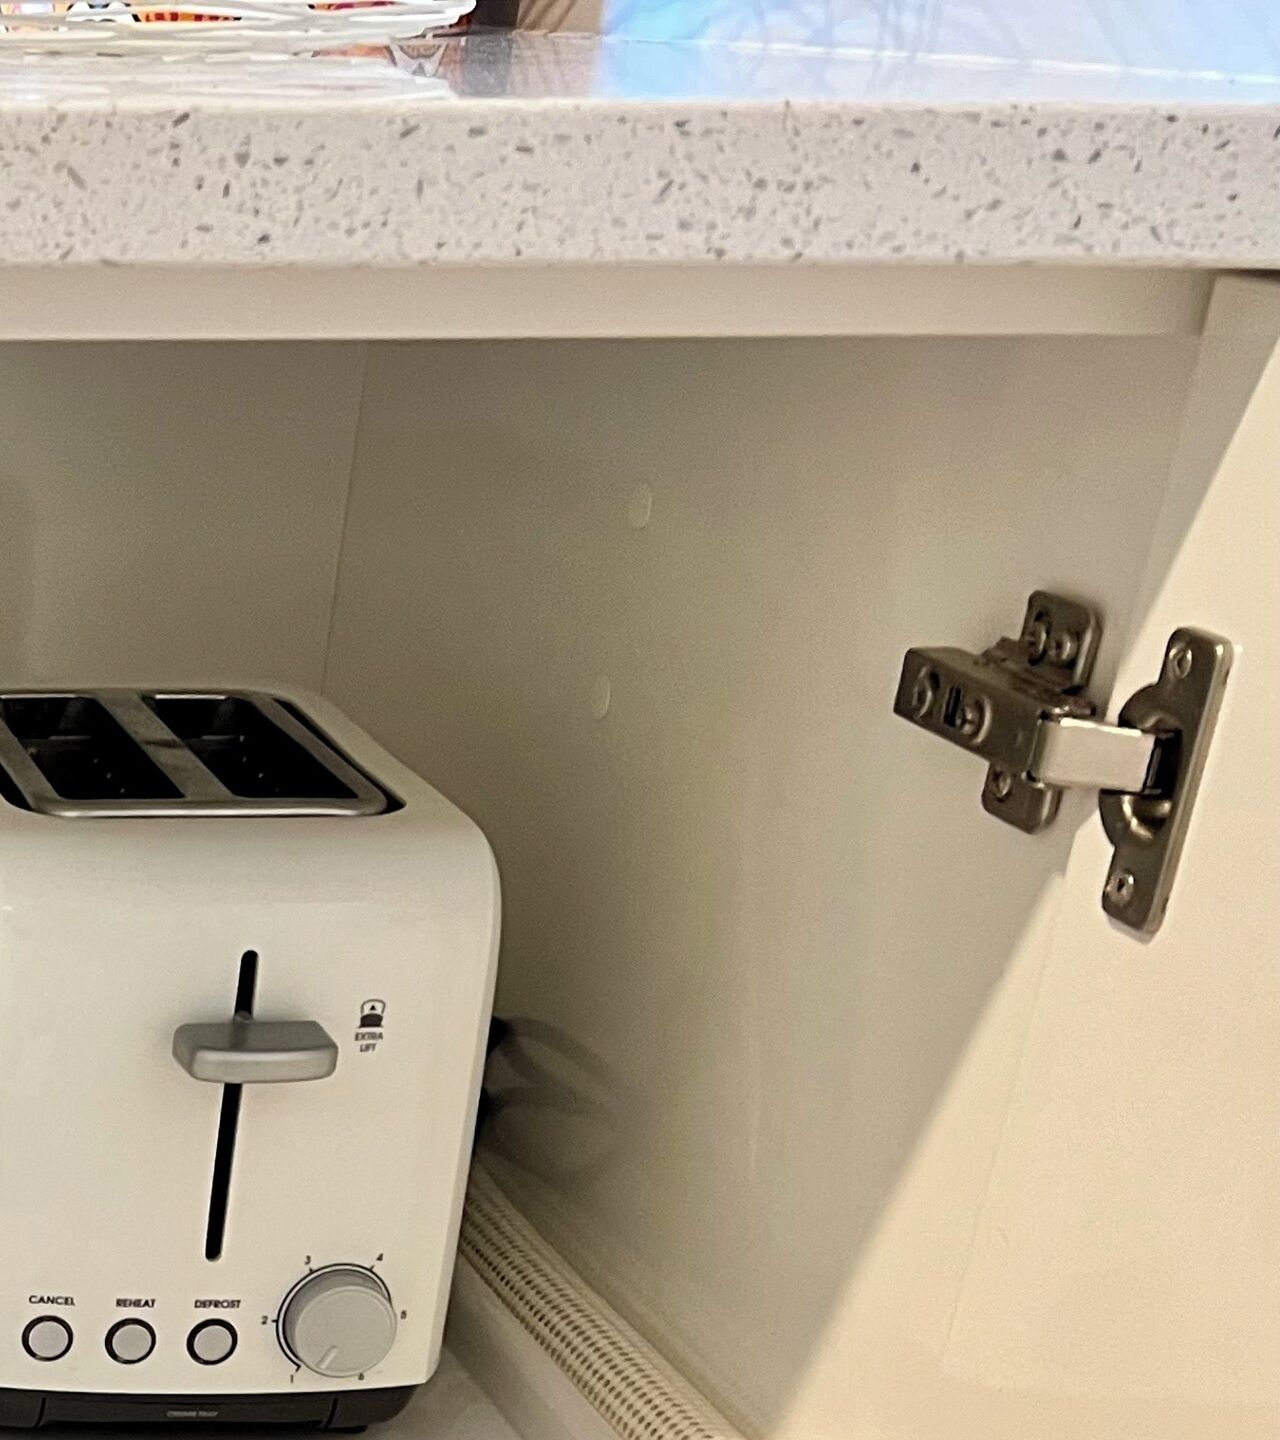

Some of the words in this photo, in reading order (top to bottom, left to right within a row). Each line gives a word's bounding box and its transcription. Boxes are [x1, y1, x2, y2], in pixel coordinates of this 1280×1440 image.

[354, 1031, 384, 1042] EXTRA
[359, 1042, 377, 1053] LIFT
[304, 1254, 312, 1266] 3
[375, 1252, 384, 1262] 4
[28, 1294, 76, 1306] CANCEL
[115, 1298, 157, 1309] REHEAT
[193, 1298, 242, 1309] DEFROST
[260, 1315, 269, 1326] 2
